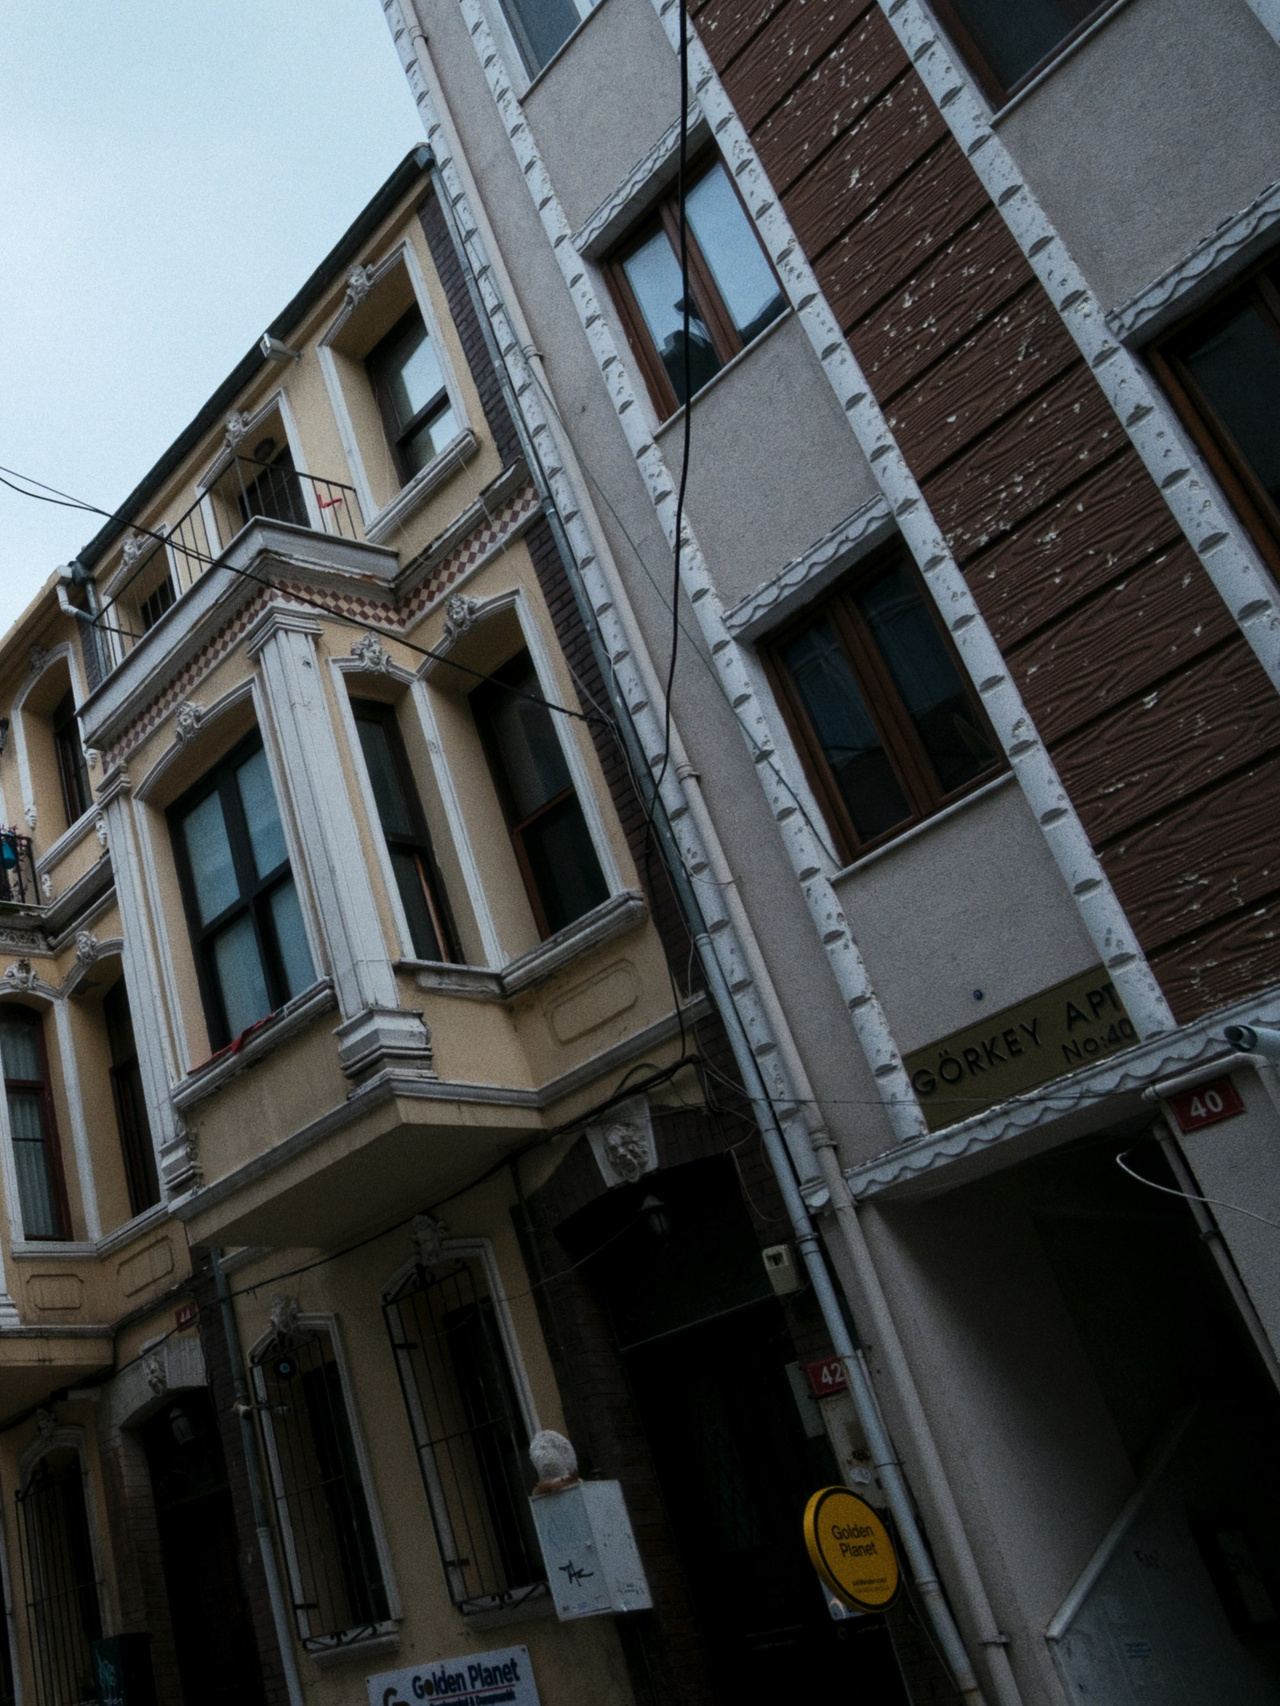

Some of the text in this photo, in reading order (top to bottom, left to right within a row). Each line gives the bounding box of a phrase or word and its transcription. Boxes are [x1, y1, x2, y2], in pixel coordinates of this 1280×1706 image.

[1061, 1017, 1136, 1065] No:40
[911, 1017, 1043, 1096] GÖRKEY
[1189, 1090, 1224, 1118] 40
[821, 1362, 845, 1385] 42
[831, 1524, 874, 1540] Golden
[839, 1541, 878, 1558] Planet
[412, 1657, 520, 1699] Golden Planet
